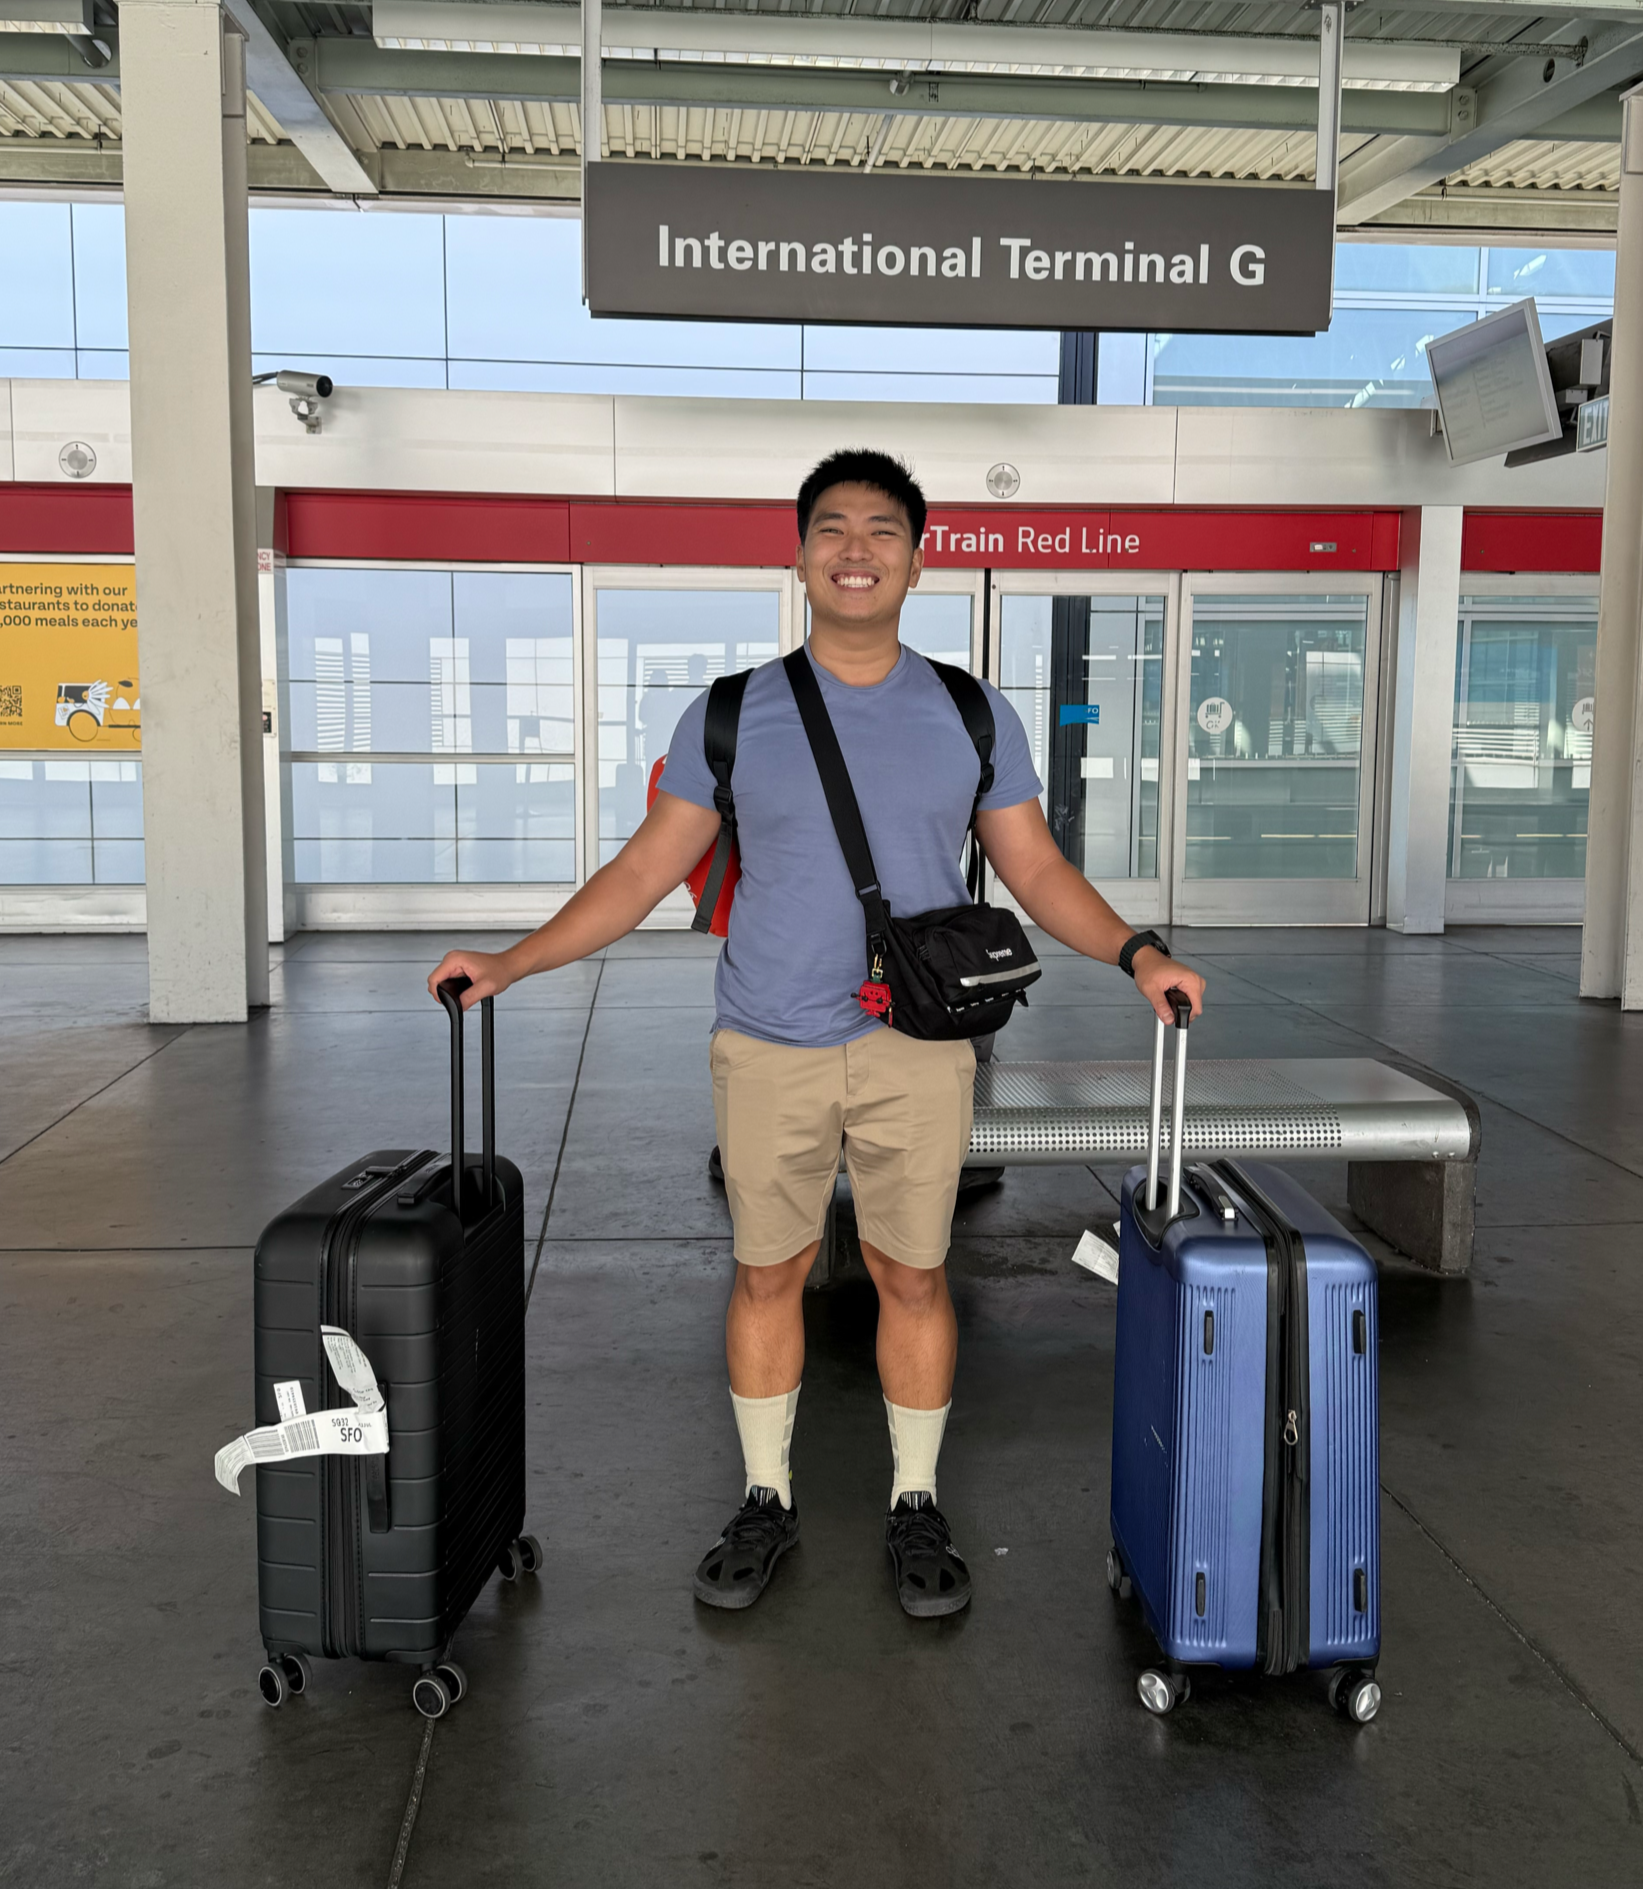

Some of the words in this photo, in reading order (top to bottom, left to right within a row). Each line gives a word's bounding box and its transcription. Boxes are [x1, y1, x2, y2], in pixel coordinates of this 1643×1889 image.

[658, 224, 982, 279] International
[1000, 236, 1210, 284] Terminal
[1230, 244, 1267, 286] G
[1583, 399, 1609, 445] EXIT
[919, 525, 1004, 553] rTrain
[1018, 526, 1071, 553] Red
[1082, 526, 1140, 554] Line
[0, 582, 63, 598] rtnering
[66, 583, 99, 596] with
[103, 586, 128, 596] our
[74, 600, 89, 612] to
[92, 599, 137, 612] donat
[35, 614, 79, 627] meals
[82, 615, 118, 628] each
[121, 618, 138, 631] ye
[340, 1427, 363, 1443] SFO
